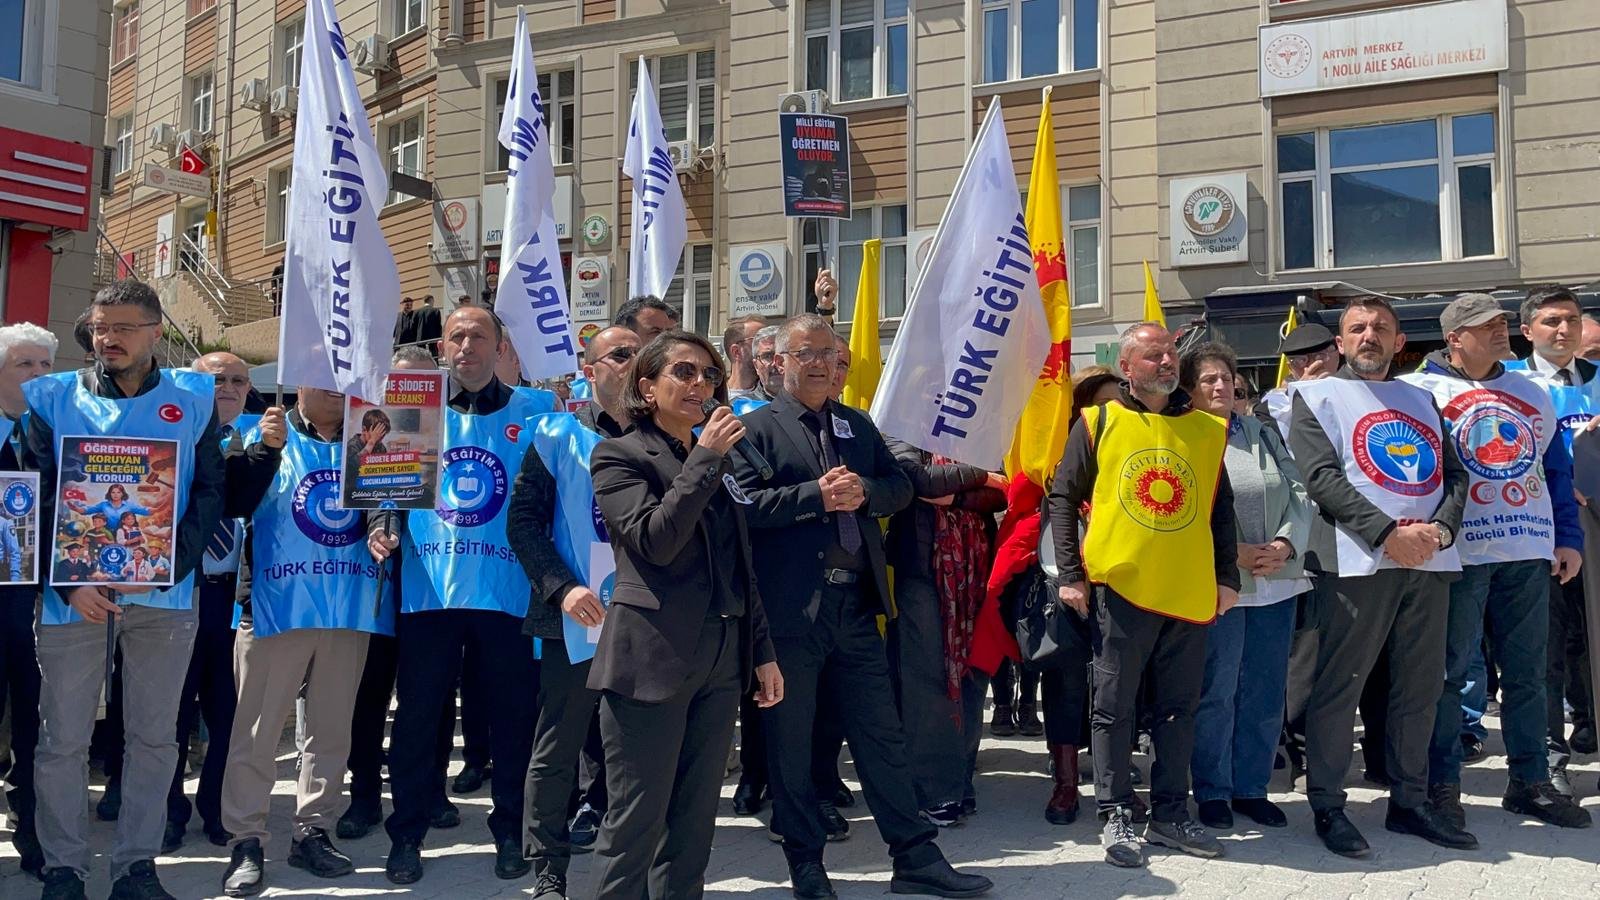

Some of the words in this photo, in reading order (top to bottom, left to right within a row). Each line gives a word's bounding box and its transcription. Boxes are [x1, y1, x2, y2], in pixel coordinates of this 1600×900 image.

[1322, 47, 1358, 60] ARTVİN
[1363, 41, 1403, 55] MERKEZ
[1323, 67, 1328, 78] 1
[1333, 61, 1361, 77] NOLU
[1364, 56, 1388, 73] AİLE
[1390, 53, 1434, 71] SAĞLIĞI
[1437, 44, 1486, 65] MERKEZİ
[795, 118, 814, 127] MİLLİ
[814, 118, 836, 129] EĞİTİM
[796, 127, 836, 140] UYUMA!
[791, 137, 840, 151] ÖĞRETMEN
[1179, 246, 1206, 255] Artvin
[1208, 243, 1240, 254] Şubesi
[735, 295, 757, 303] ensar
[327, 257, 351, 375] TÜRK
[931, 339, 999, 439] TÜRK
[386, 393, 426, 405] OLERANS!
[88, 454, 141, 464] KORUYAN
[390, 454, 404, 463] DUR
[95, 474, 137, 483] KORUR.
[1174, 463, 1194, 488] SEN
[1460, 517, 1489, 529] mek
[320, 533, 348, 545] 1992
[1465, 527, 1506, 542] Güçlü
[263, 560, 307, 581] TÜRK
